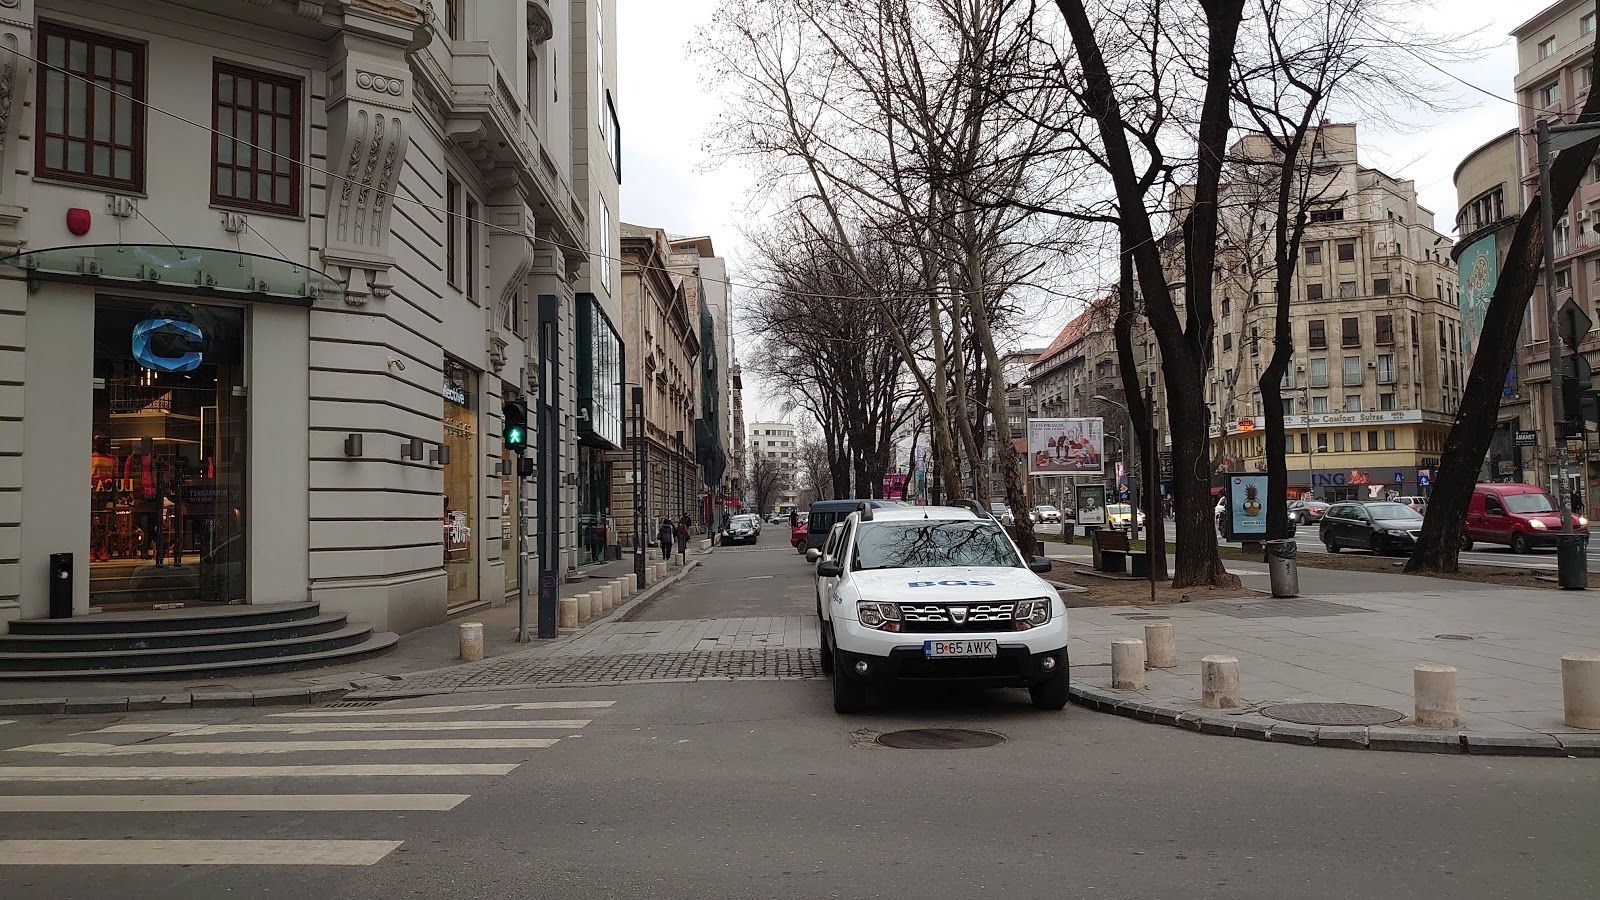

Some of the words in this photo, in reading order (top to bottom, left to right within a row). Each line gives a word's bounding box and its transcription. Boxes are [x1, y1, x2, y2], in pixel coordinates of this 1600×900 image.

[1312, 473, 1346, 486] ING
[907, 580, 996, 588] BGS
[935, 642, 944, 654] B
[949, 642, 963, 654] 65
[966, 641, 992, 654] AWK
